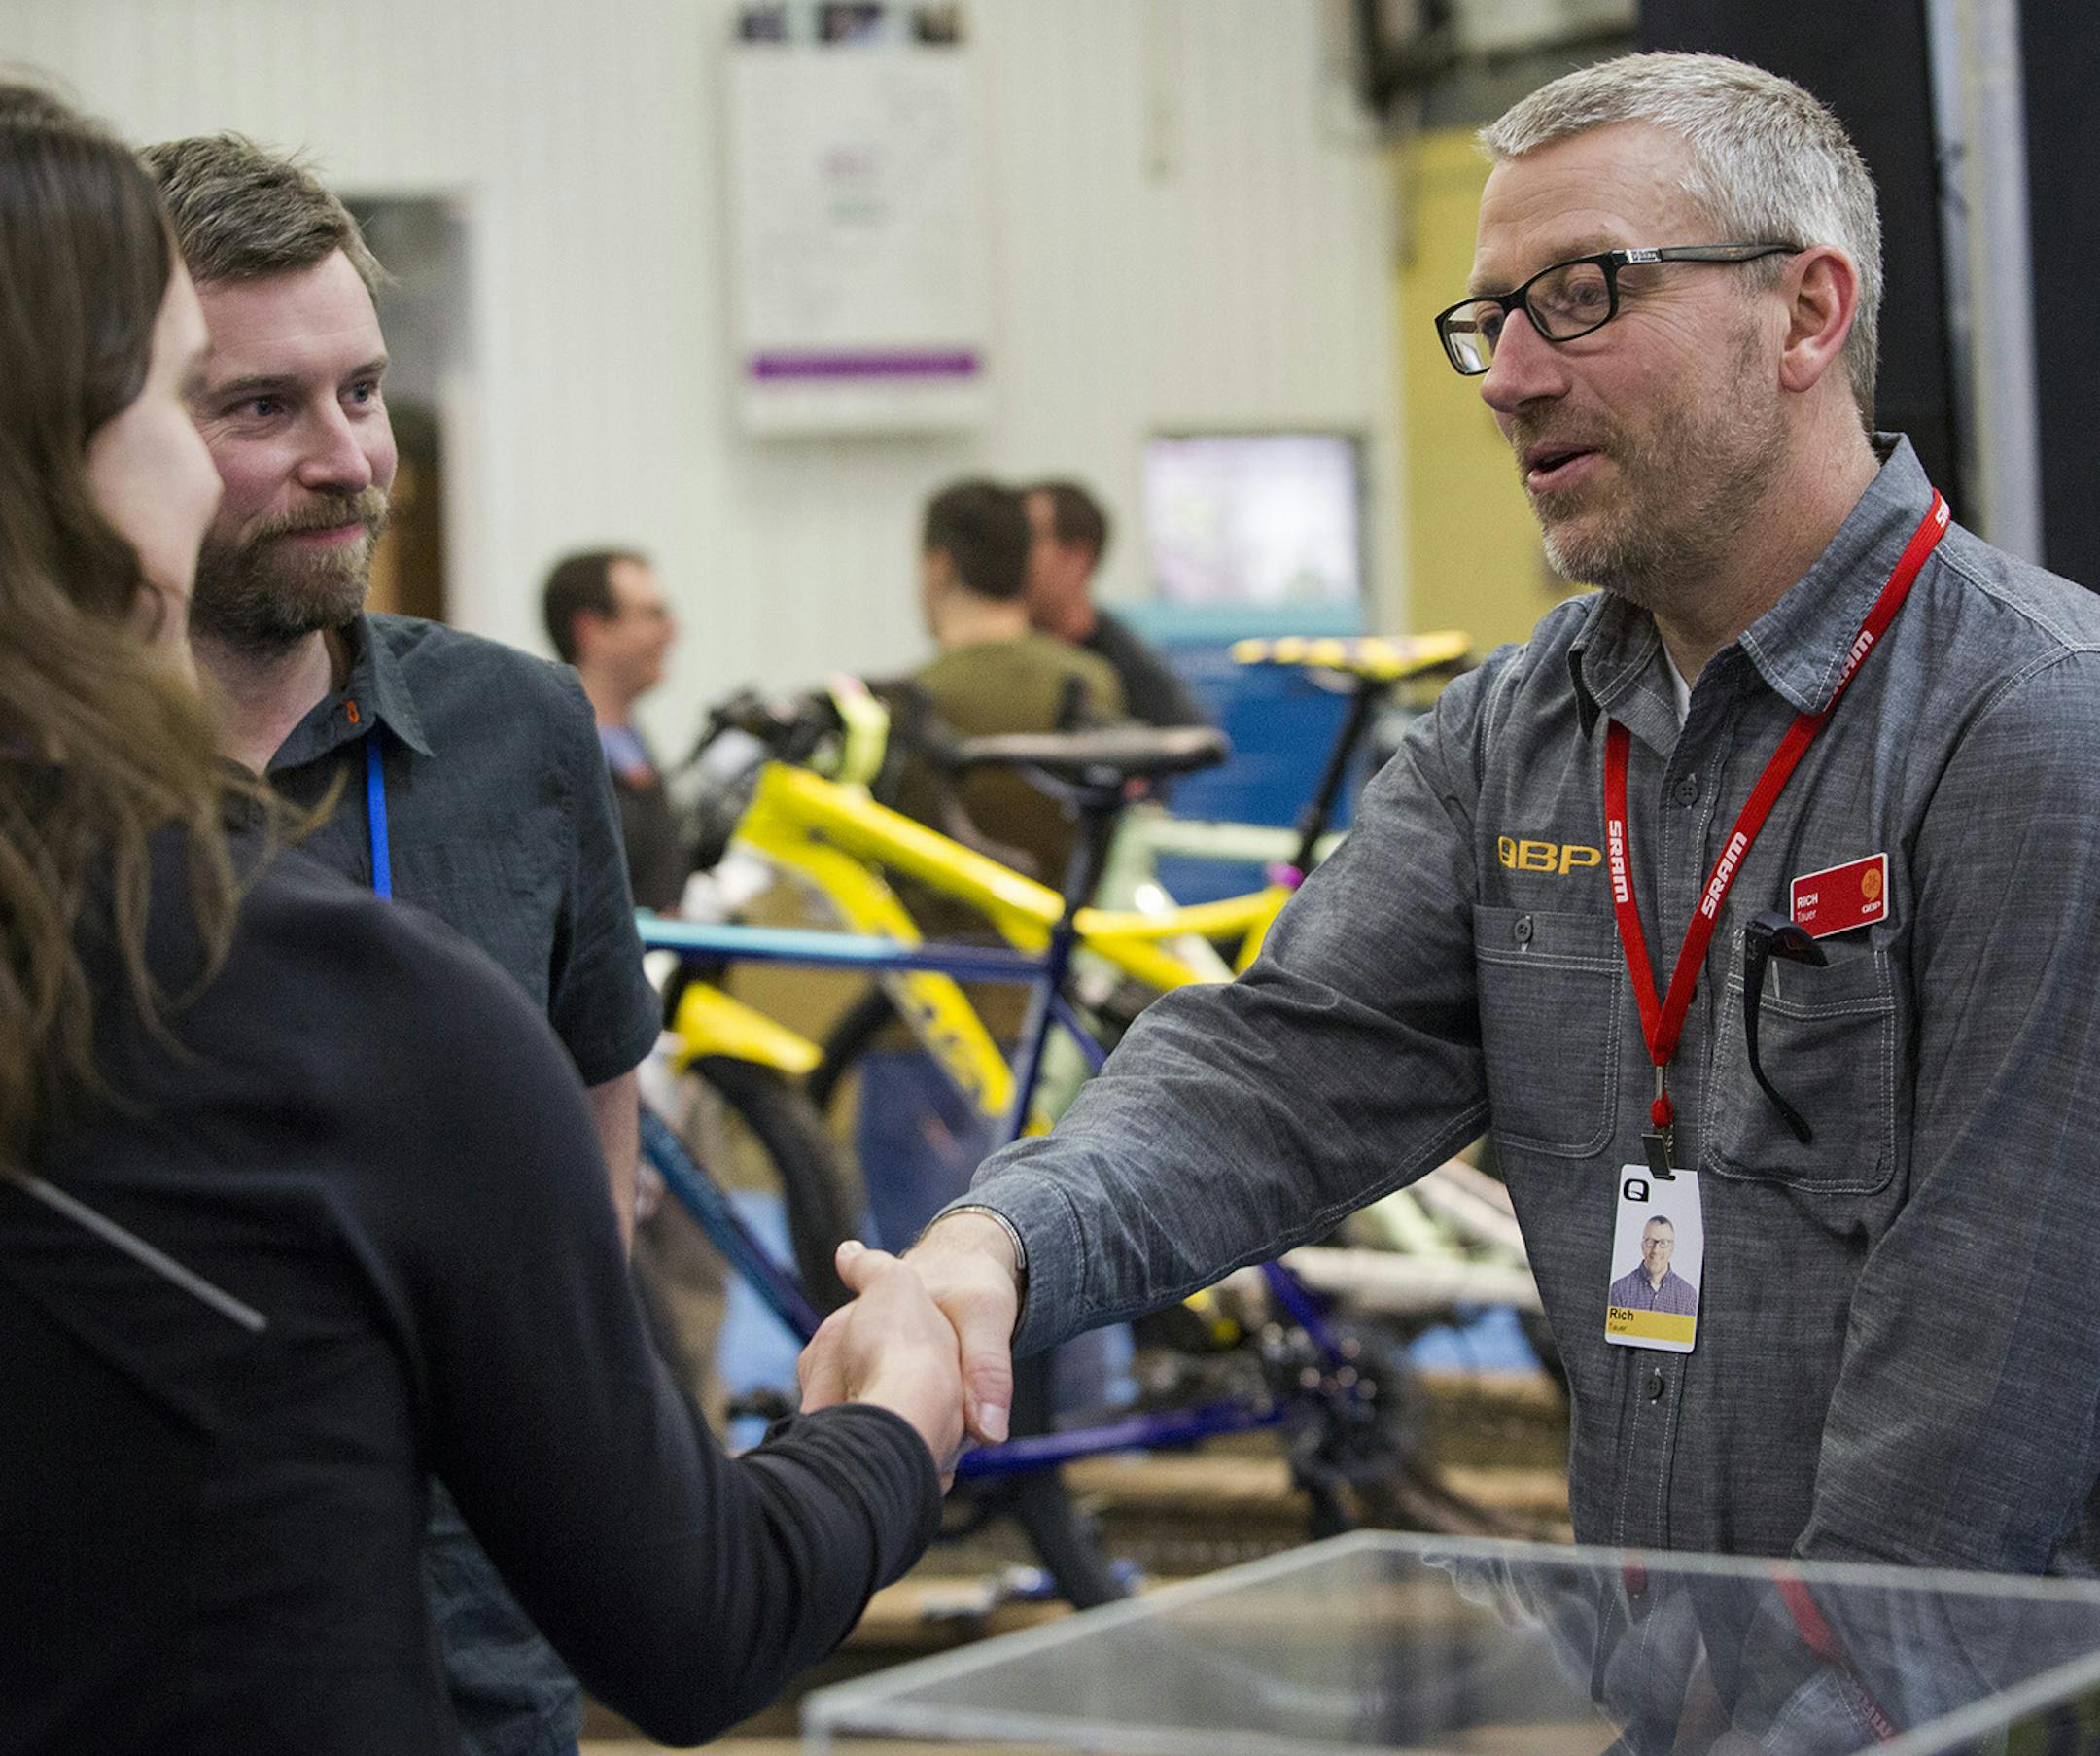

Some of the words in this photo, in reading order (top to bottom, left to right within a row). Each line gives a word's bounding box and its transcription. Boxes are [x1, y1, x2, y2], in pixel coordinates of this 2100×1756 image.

[1498, 836, 1601, 875] QBP
[1609, 820, 1629, 903] SRAM
[1702, 832, 1747, 919] SRAM
[1797, 893, 1819, 909] RICH
[1609, 1308, 1634, 1321] Rich
